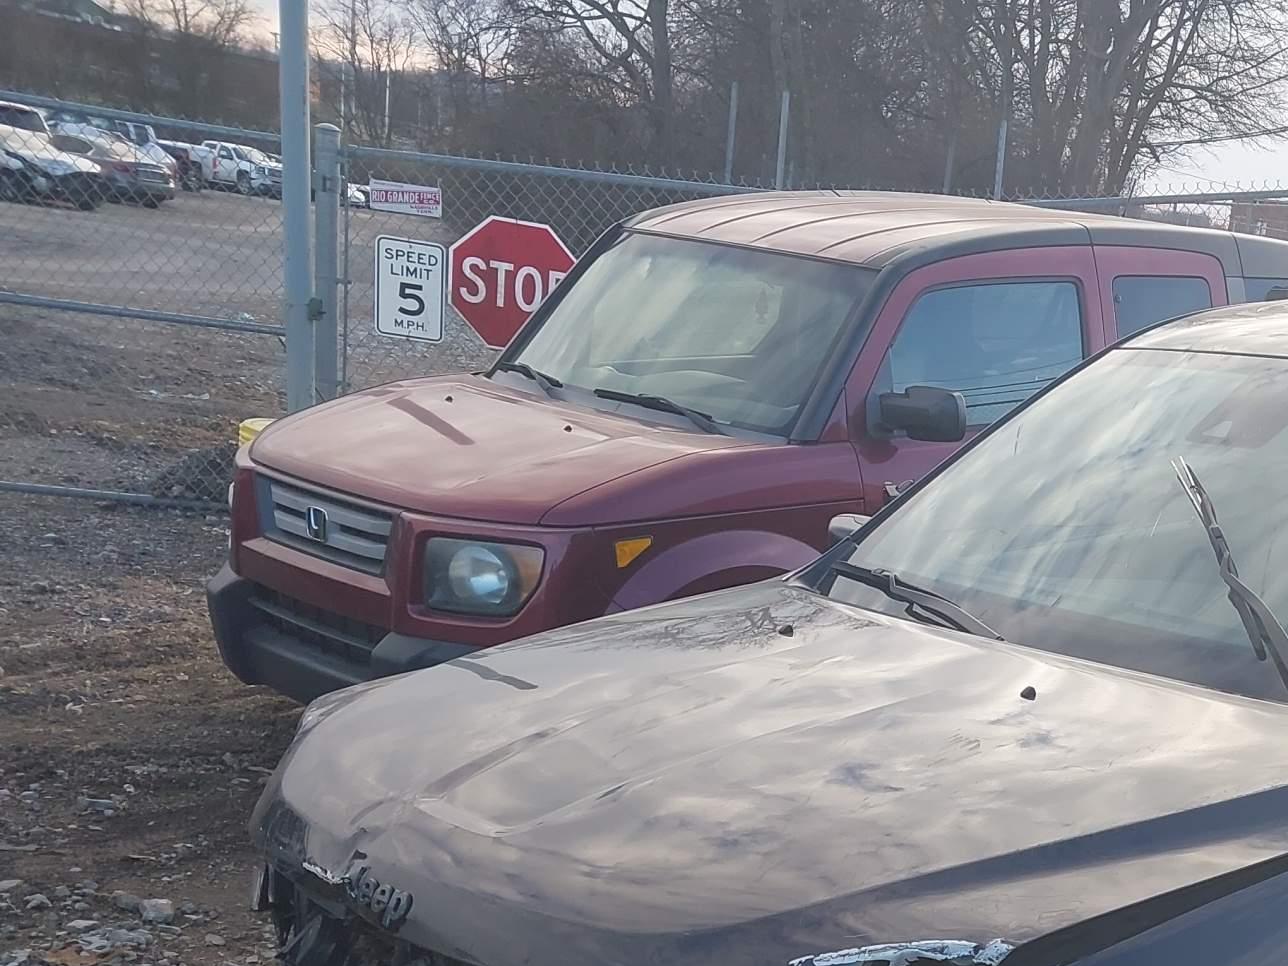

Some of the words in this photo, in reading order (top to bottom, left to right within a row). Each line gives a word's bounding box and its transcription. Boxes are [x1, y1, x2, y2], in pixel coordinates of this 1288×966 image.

[372, 190, 386, 202] RIO
[387, 191, 420, 204] GRANDE
[384, 247, 438, 267] SPEED
[390, 262, 433, 281] LIMIT
[398, 282, 426, 317] 5
